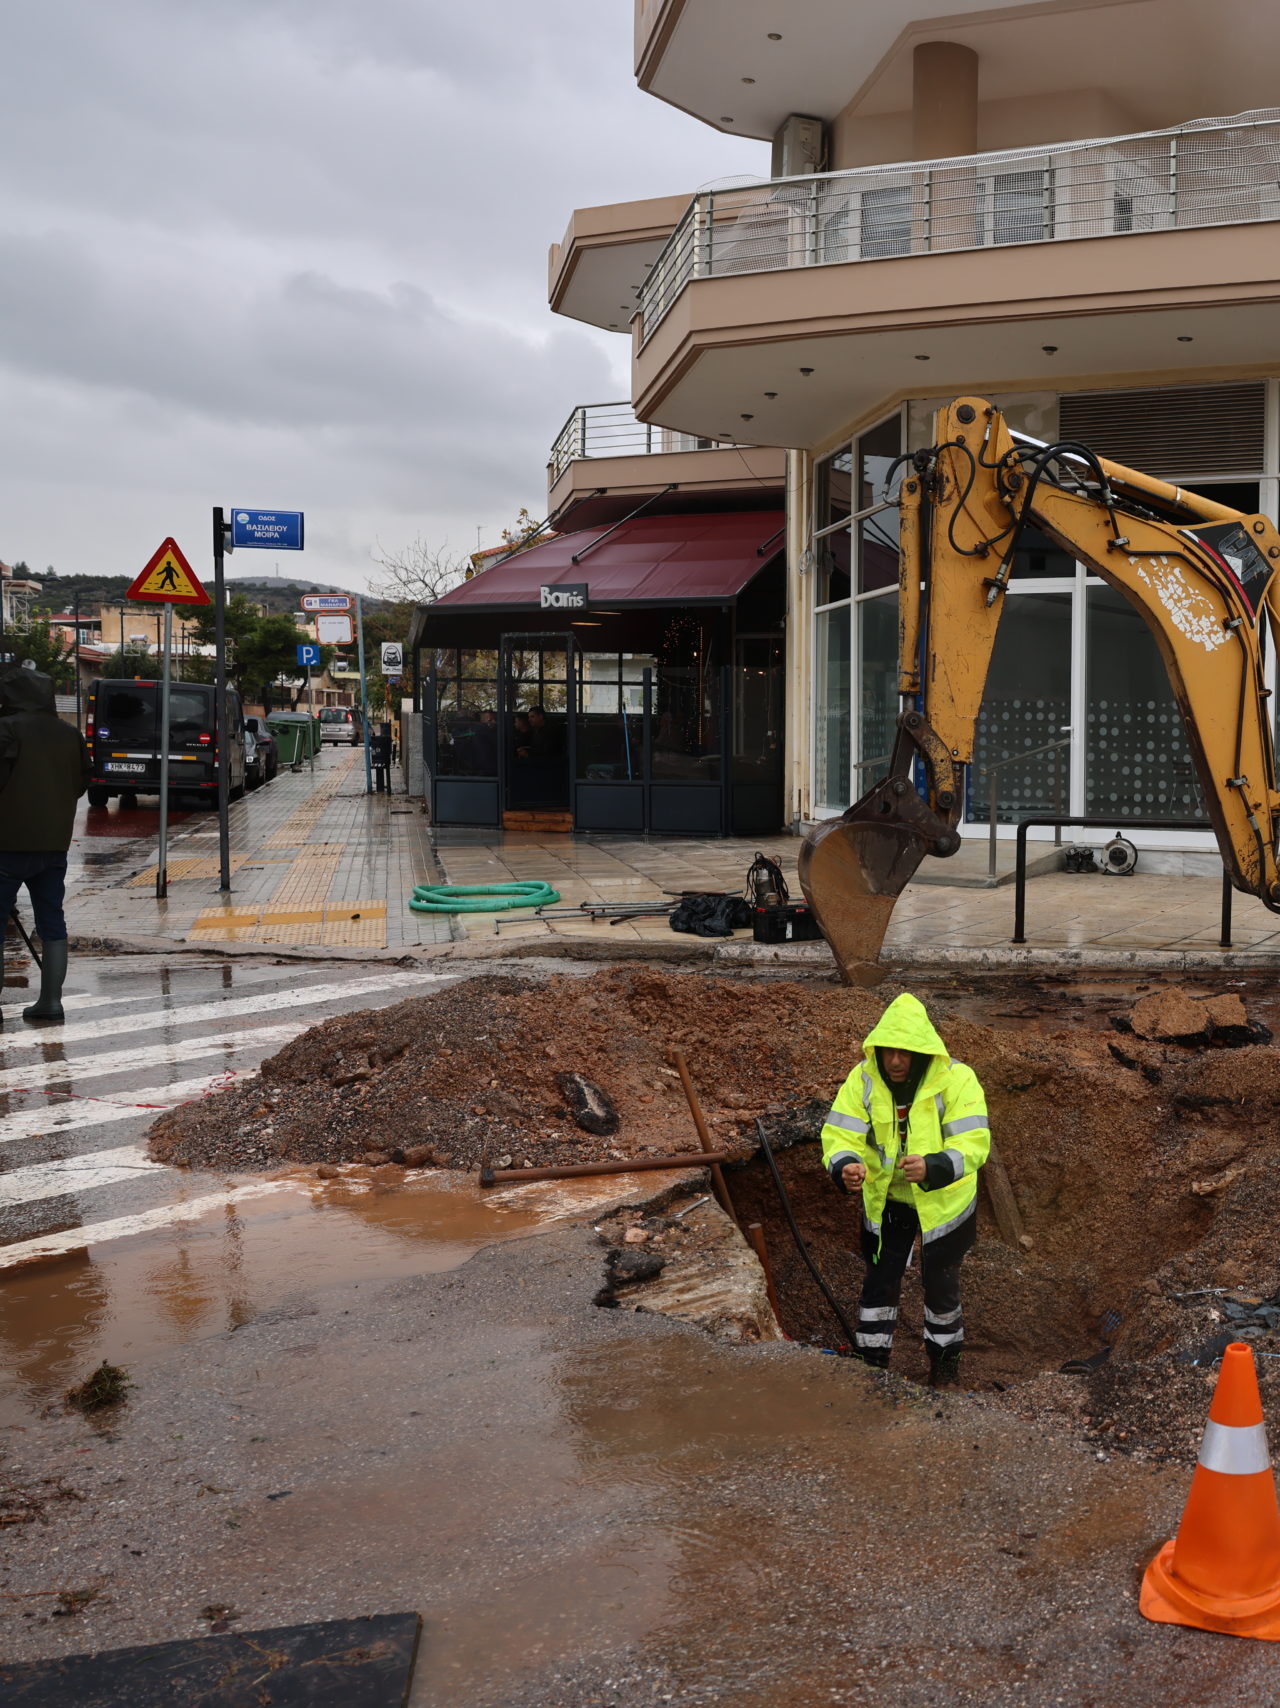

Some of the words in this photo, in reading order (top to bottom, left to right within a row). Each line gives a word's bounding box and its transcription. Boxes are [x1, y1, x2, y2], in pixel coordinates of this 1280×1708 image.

[246, 523, 288, 532] ΒΑΣΙΛΕΙΟΥ
[540, 586, 584, 608] Barris
[303, 647, 314, 664] P
